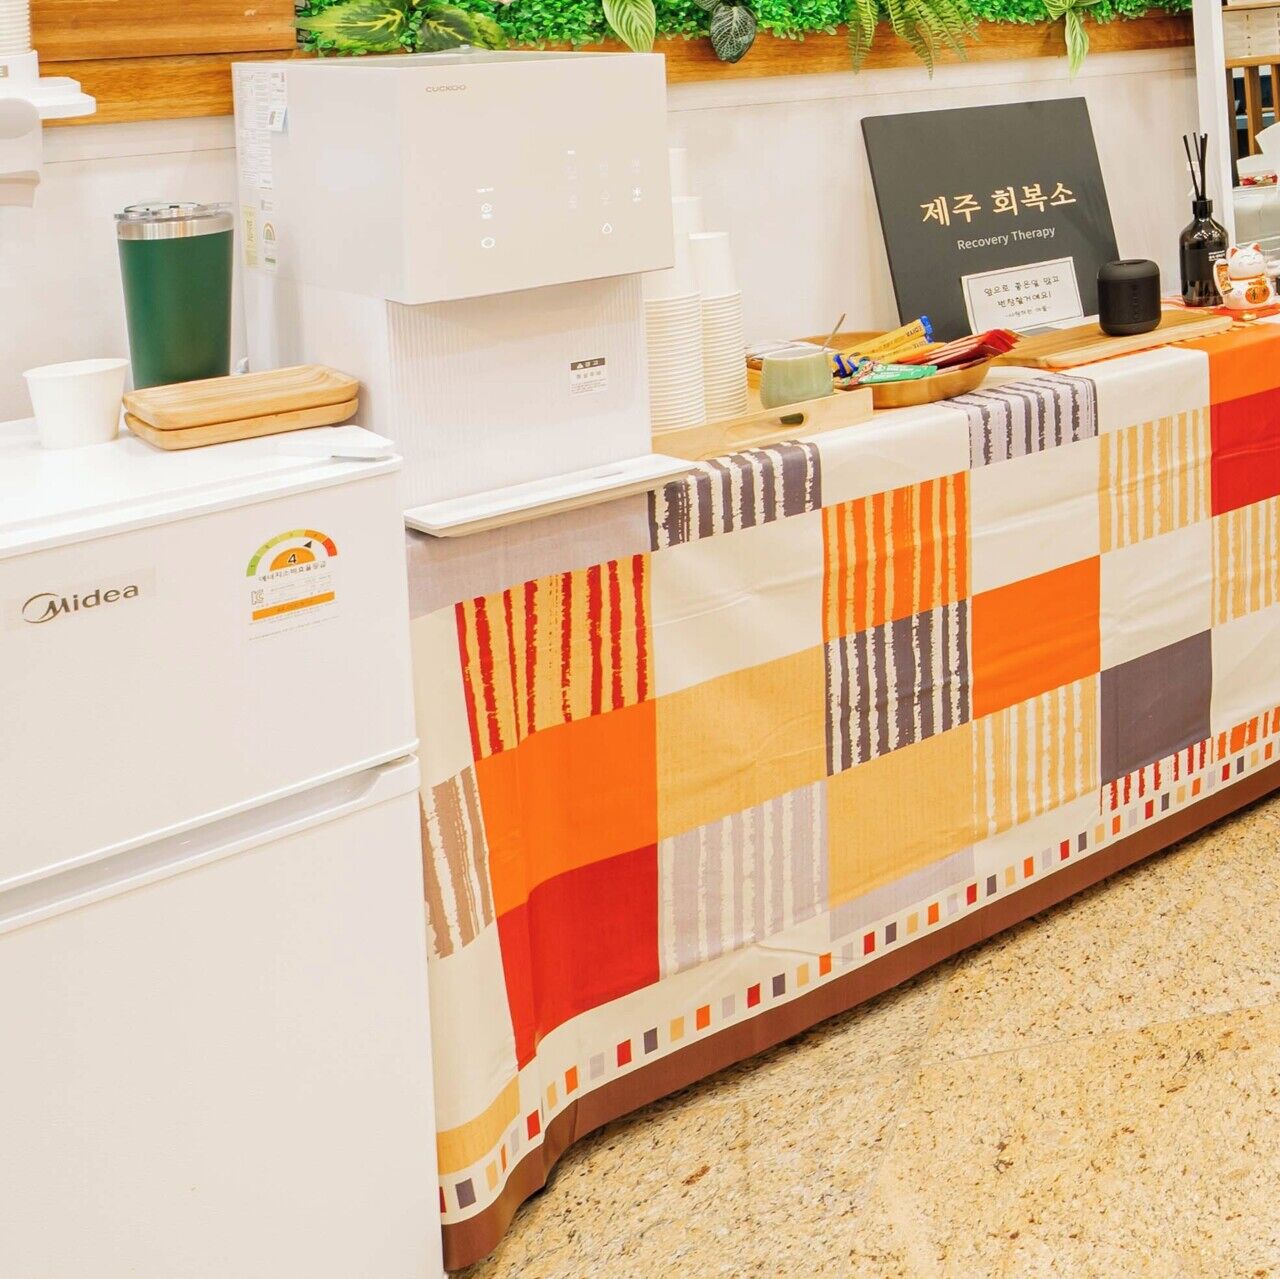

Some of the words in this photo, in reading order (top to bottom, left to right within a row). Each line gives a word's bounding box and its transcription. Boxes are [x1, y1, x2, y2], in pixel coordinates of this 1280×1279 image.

[919, 193, 982, 227] 제주
[990, 181, 1077, 217] 회복소
[957, 233, 1010, 251] Recovery
[1011, 227, 1056, 243] Therapy
[288, 553, 297, 564] 4
[21, 584, 139, 624] Midea
